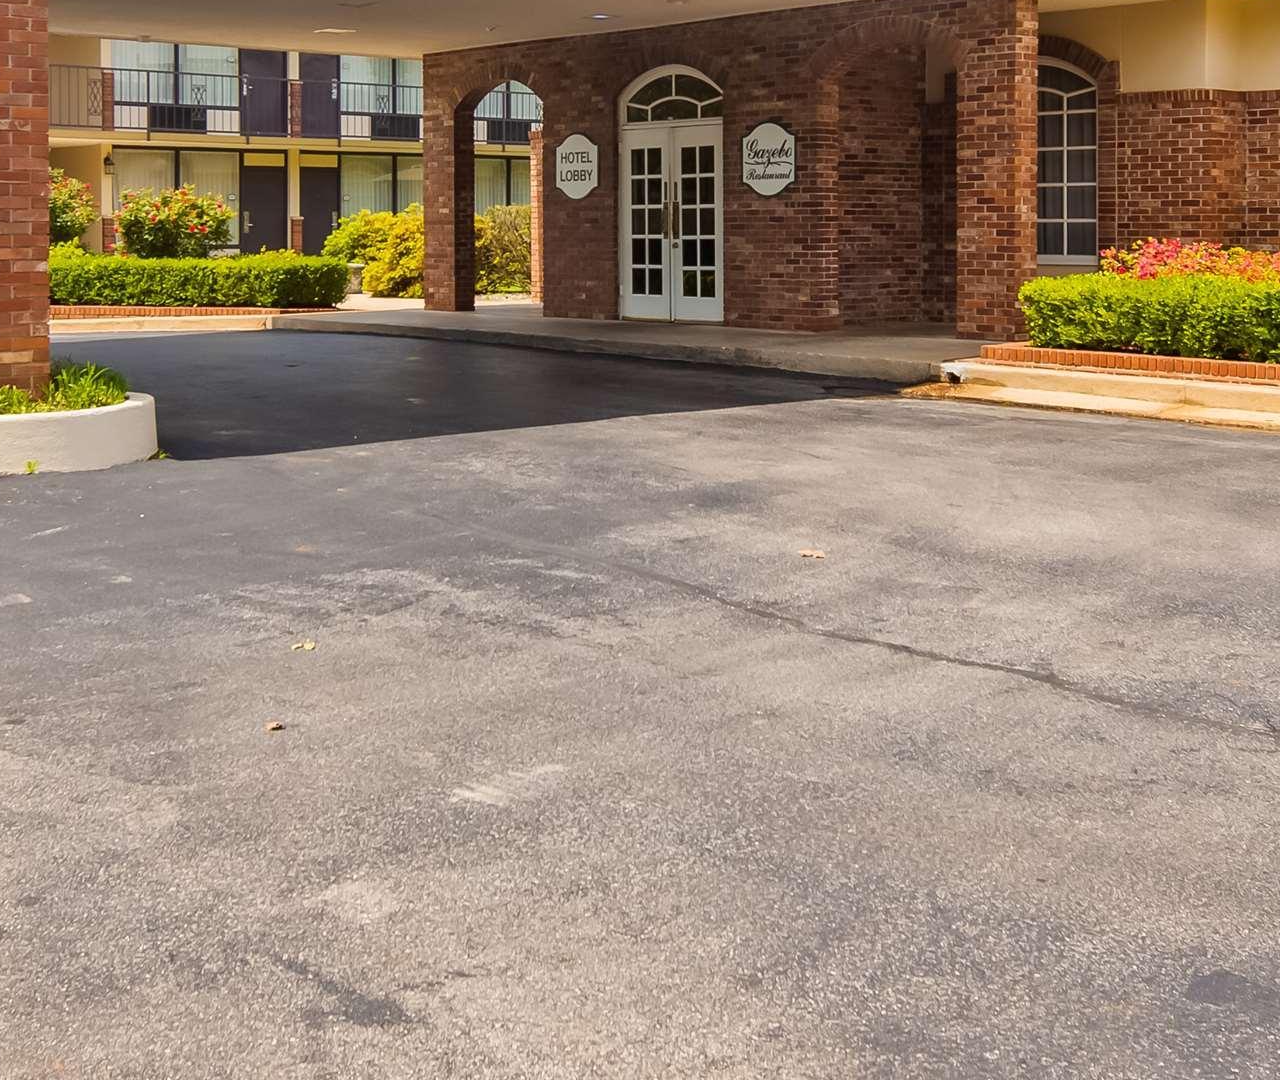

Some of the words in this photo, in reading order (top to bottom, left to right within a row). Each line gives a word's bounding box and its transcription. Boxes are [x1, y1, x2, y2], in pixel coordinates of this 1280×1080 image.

[560, 151, 592, 164] HOTEL
[746, 138, 793, 167] Gazebo
[560, 169, 593, 182] LOBBY
